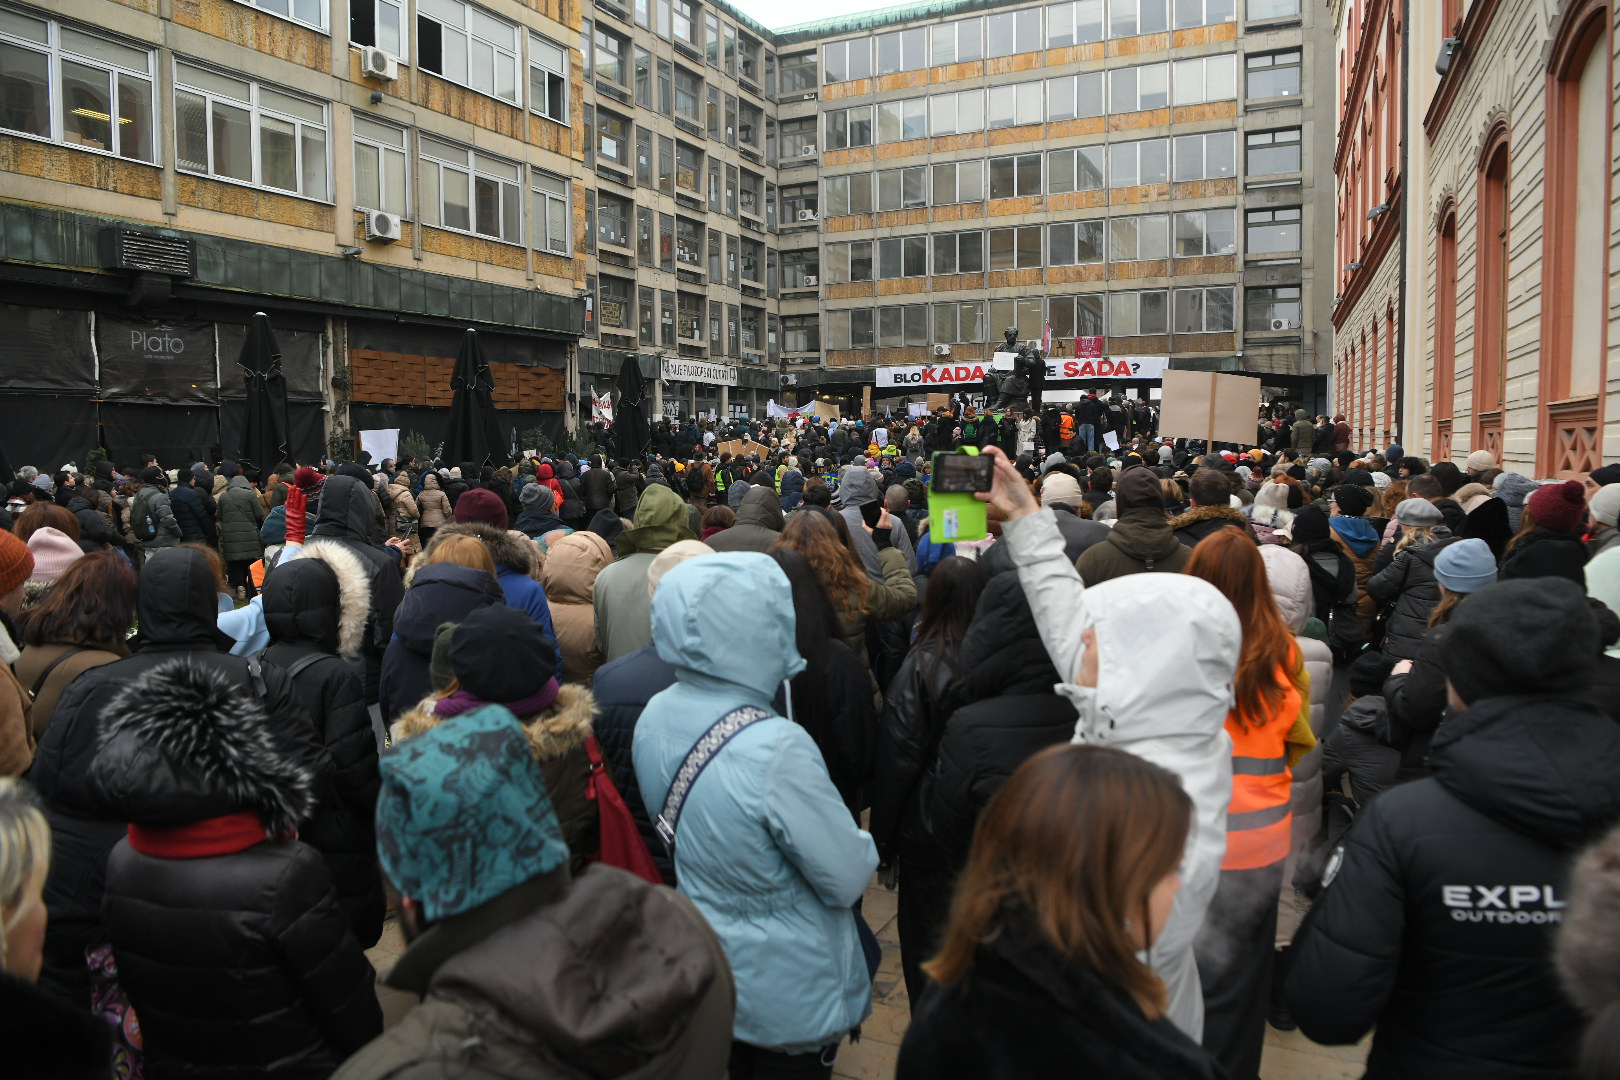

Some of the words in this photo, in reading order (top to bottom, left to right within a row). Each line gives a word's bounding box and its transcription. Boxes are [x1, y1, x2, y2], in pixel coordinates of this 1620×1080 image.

[131, 330, 184, 354] Plato
[893, 366, 985, 384] BLOKADA
[1063, 360, 1141, 378] SADA?
[1442, 885, 1568, 909] EXPL
